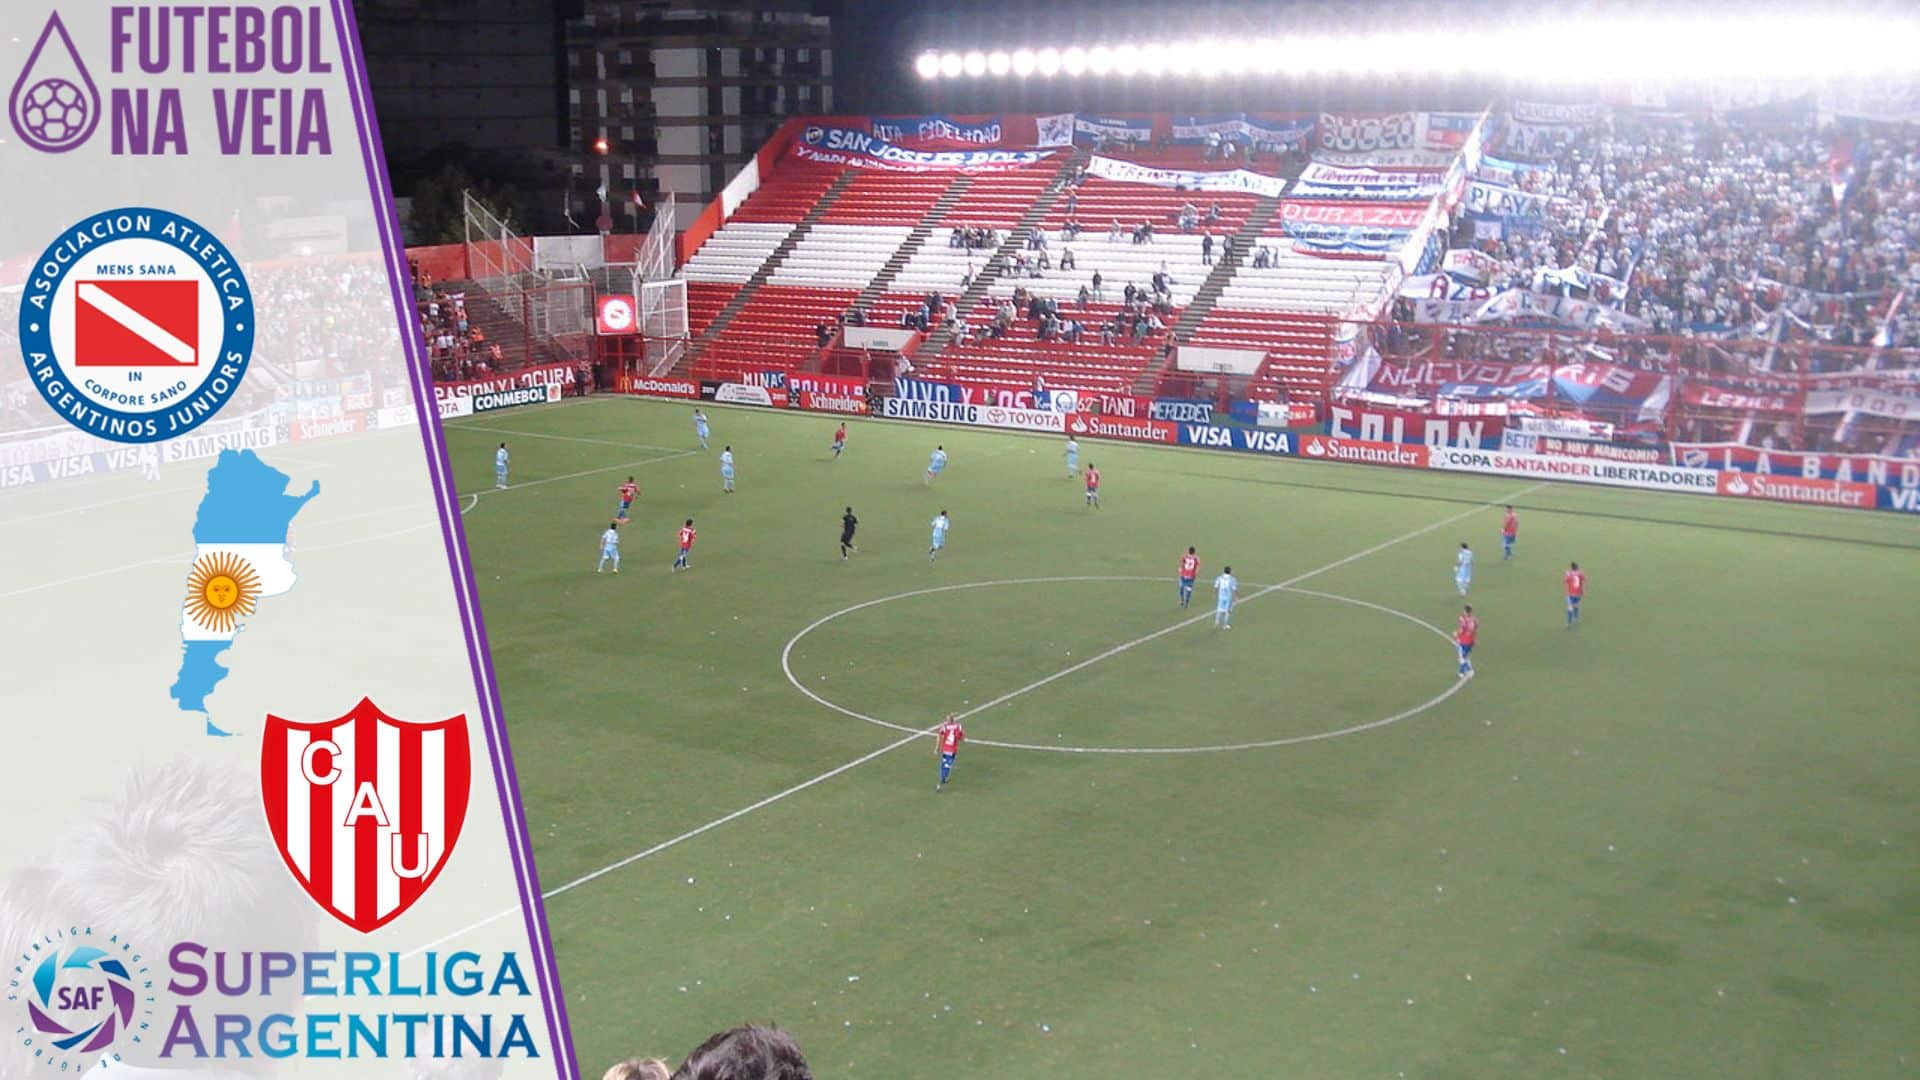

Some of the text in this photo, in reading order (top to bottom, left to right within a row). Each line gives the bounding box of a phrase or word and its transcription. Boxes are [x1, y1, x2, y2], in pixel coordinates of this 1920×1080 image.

[828, 129, 870, 151] SAN
[633, 378, 696, 394] McDonald's
[475, 387, 545, 410] CONMEBOL
[809, 392, 862, 413] Schneider
[888, 399, 978, 423] SAMSUNG
[1008, 411, 1061, 428] TOYOTA
[1089, 416, 1168, 441] Santander
[1186, 425, 1233, 447] VISA
[1243, 430, 1289, 453] VISA
[1327, 439, 1419, 466] Santander
[47, 455, 94, 480] VISA
[1450, 456, 1717, 488] COPA SANTANDER LIBERTADORES
[1751, 475, 1865, 506] Santander
